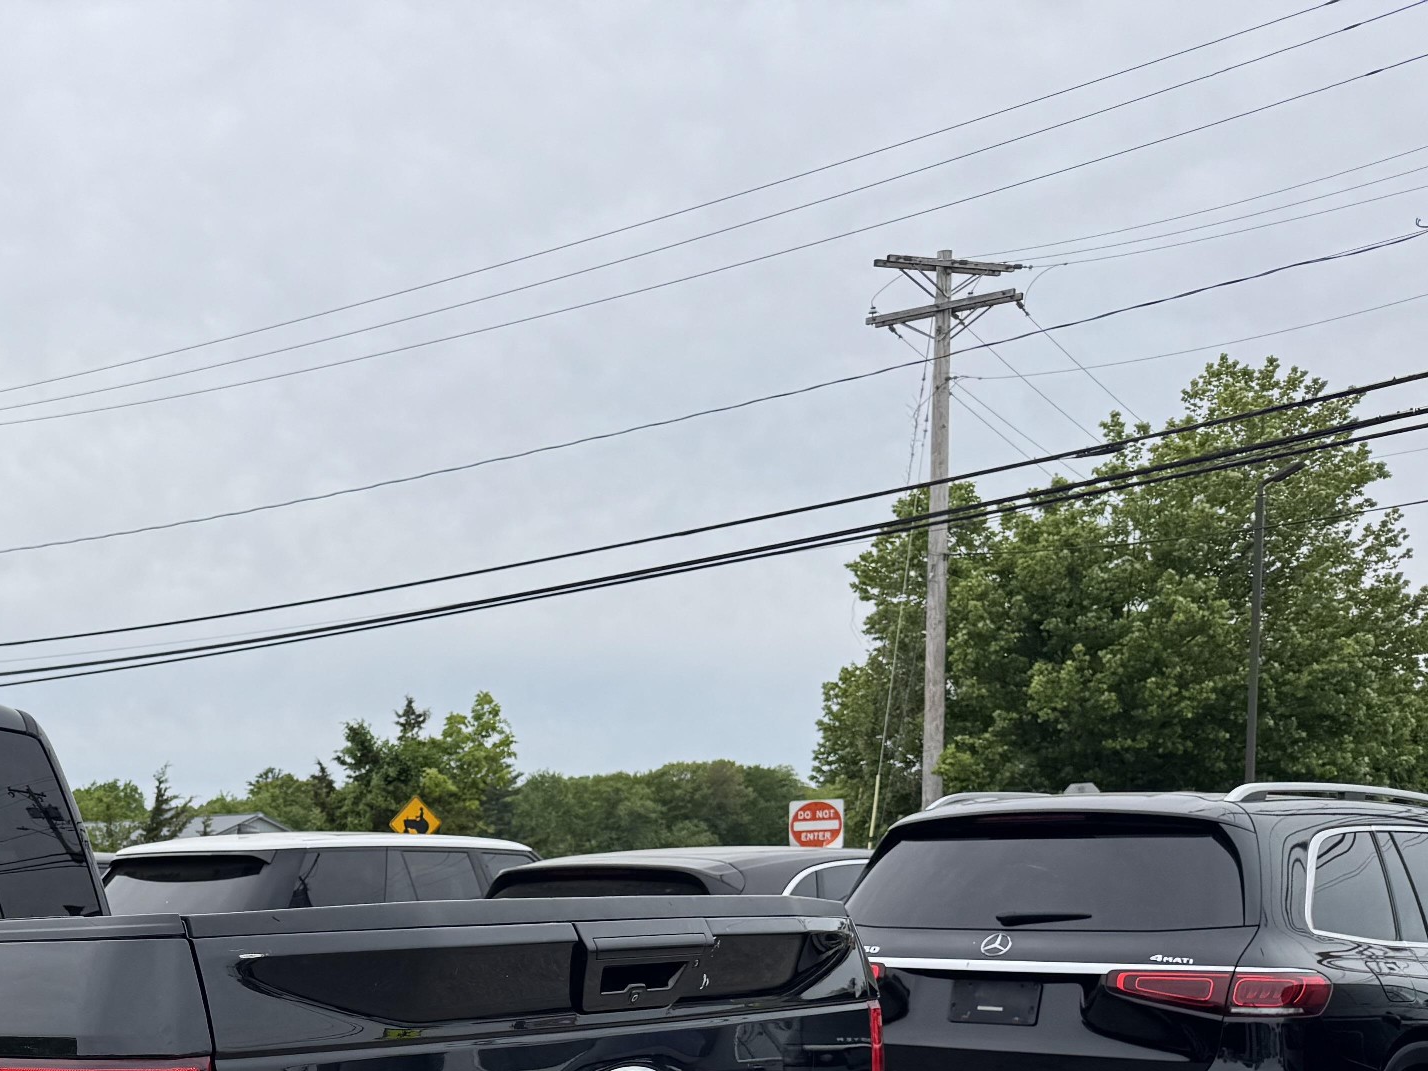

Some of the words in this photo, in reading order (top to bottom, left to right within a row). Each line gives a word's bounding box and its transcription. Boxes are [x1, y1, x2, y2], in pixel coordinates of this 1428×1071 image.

[797, 811, 811, 819] DO
[816, 809, 835, 819] NOT
[801, 832, 831, 841] ENTER
